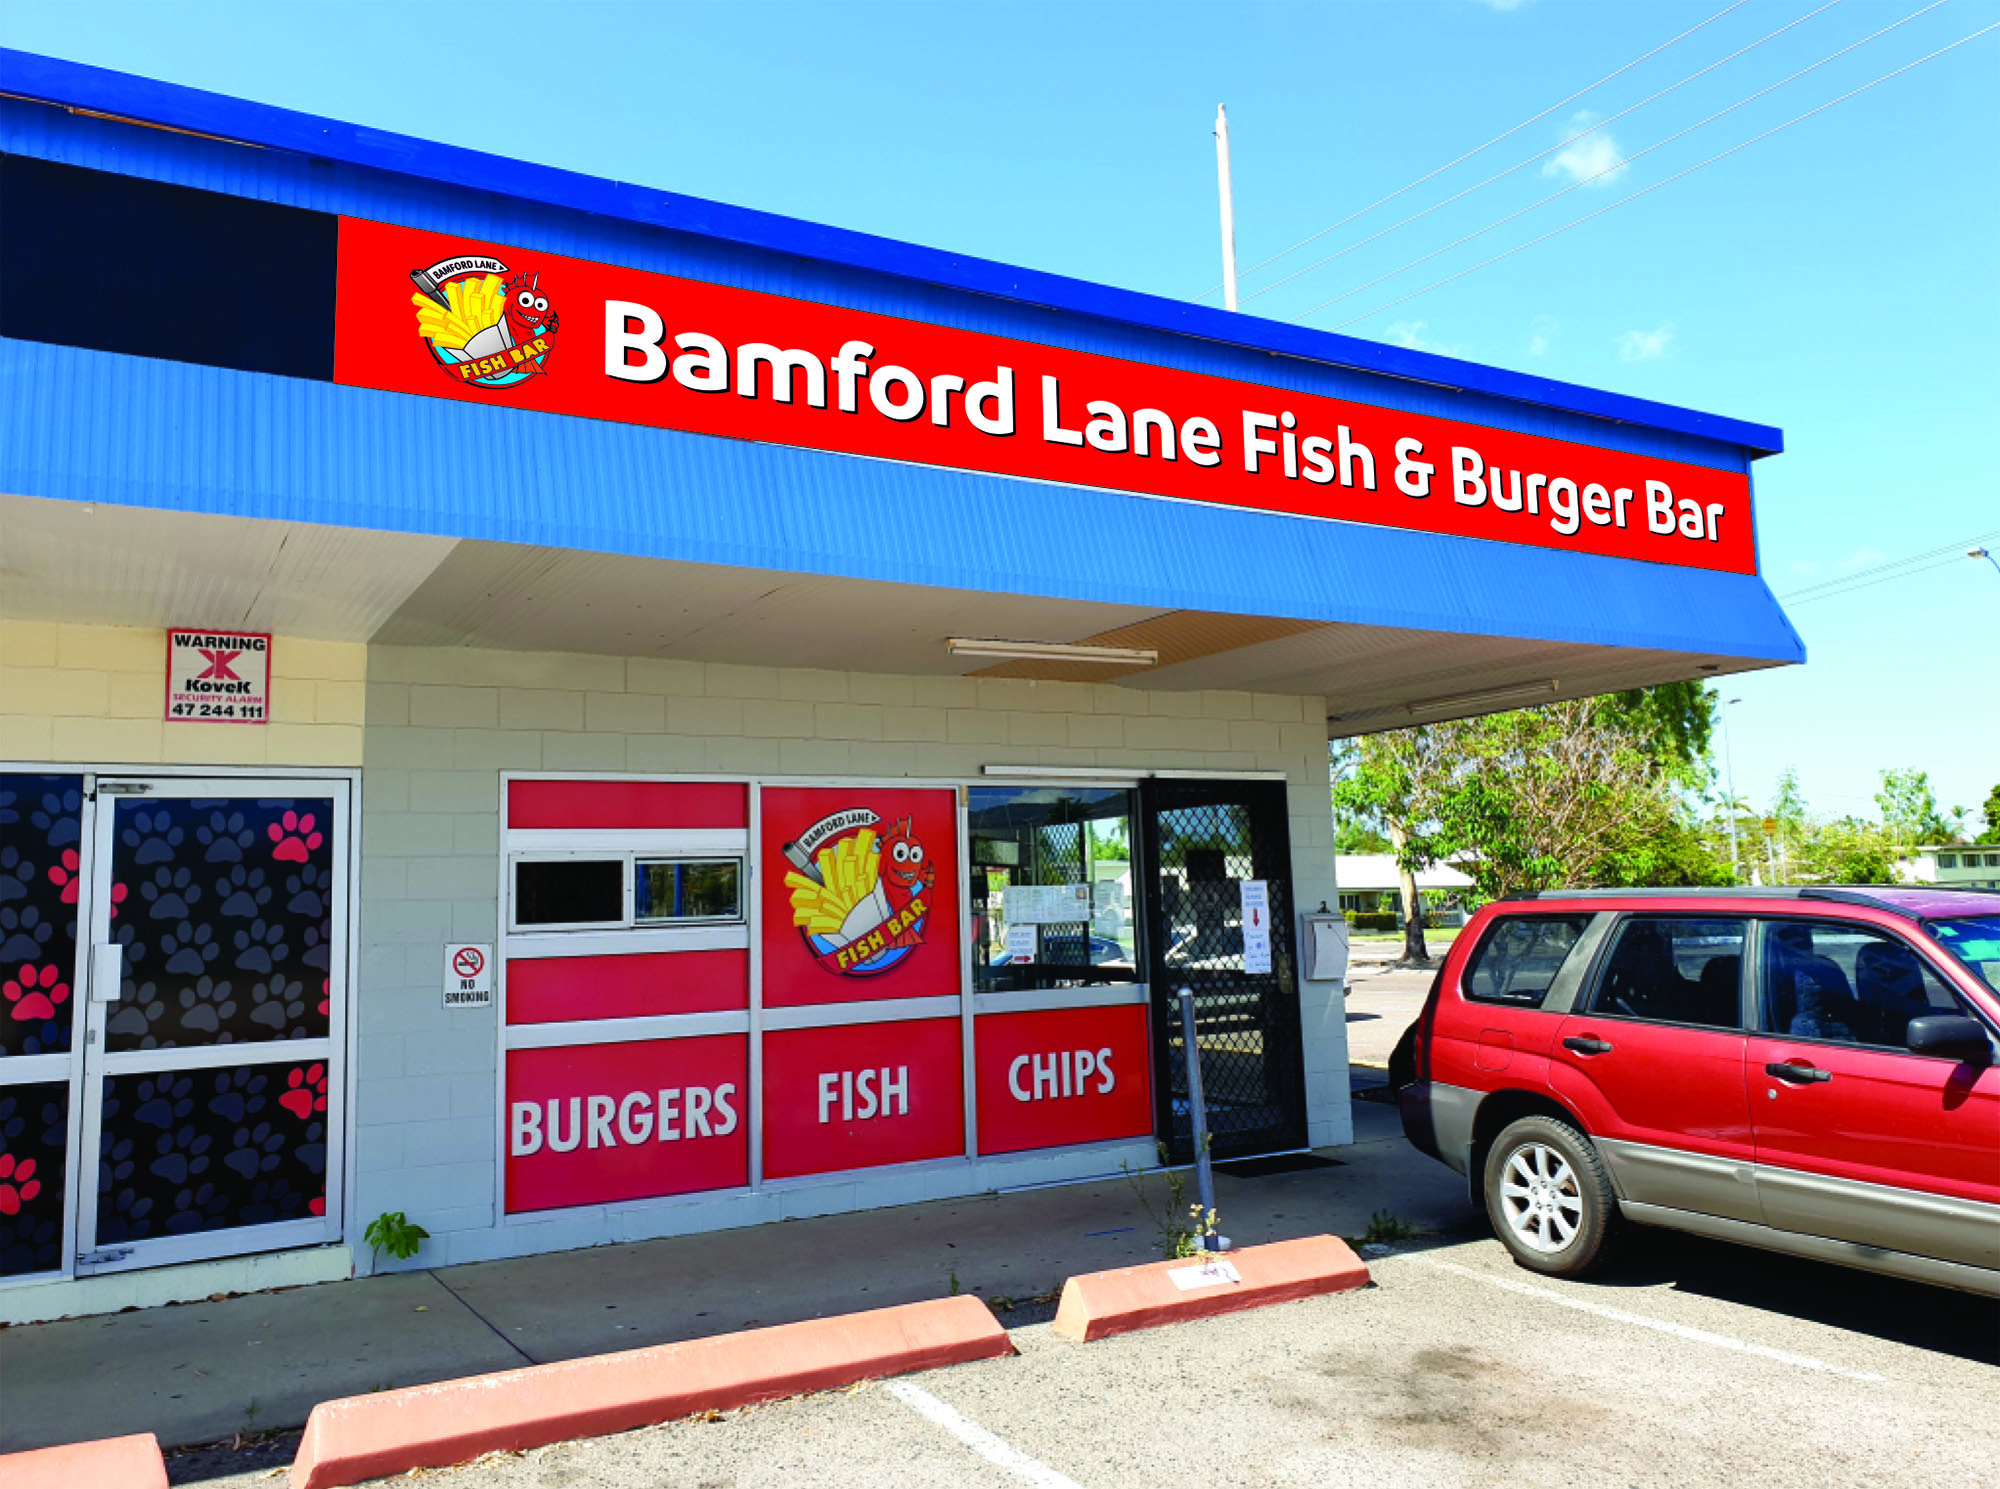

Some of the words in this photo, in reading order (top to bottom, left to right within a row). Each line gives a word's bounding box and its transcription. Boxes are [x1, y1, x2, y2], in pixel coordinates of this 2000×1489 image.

[433, 260, 473, 279] BAMFORD
[475, 259, 497, 270] LANE
[459, 354, 507, 379] FISH
[509, 338, 549, 363] BAR
[604, 299, 1016, 437] Bamford
[1041, 375, 1222, 467] Lane
[1242, 410, 1377, 491] Fish
[1394, 437, 1435, 498] &
[1451, 446, 1634, 535] Burger
[1645, 479, 1725, 542] Bar
[174, 634, 266, 651] WARNING
[172, 703, 195, 716] 47
[199, 704, 235, 717] 244
[240, 705, 263, 718] 111
[173, 693, 223, 703] SECURITY
[225, 695, 263, 704] ALARM
[803, 816, 845, 848] BAMFORD
[847, 812, 870, 824] LANE
[836, 930, 885, 969] FISH
[887, 898, 927, 936] BAR
[445, 991, 488, 1003] SMOKING
[460, 979, 475, 990] NO
[1008, 1048, 1114, 1102] CHIPS
[818, 1066, 909, 1123] FISH
[511, 1083, 738, 1157] BURGERS
